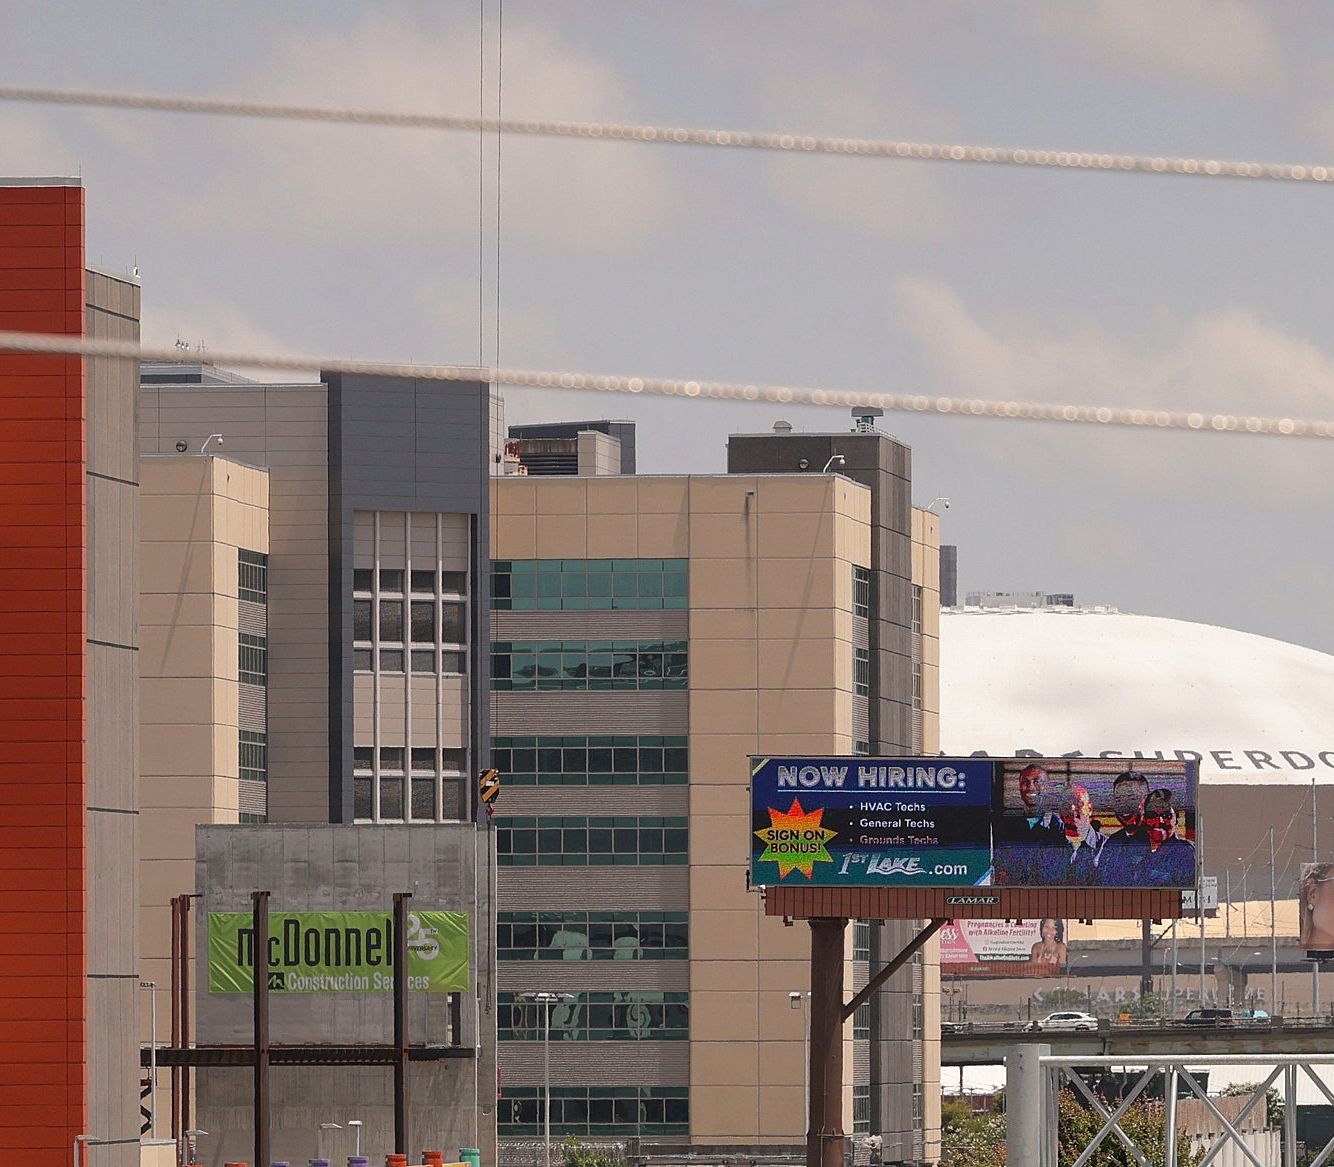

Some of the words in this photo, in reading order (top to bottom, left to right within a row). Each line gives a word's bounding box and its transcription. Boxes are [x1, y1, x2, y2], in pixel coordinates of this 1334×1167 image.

[777, 766, 849, 788] NOW
[857, 766, 967, 789] HIRING:
[860, 802, 892, 812] HVAC
[895, 802, 926, 812] Techs
[859, 818, 902, 828] General
[905, 818, 935, 828] Techs
[767, 829, 801, 841] SIGN
[803, 829, 825, 841] ON
[859, 835, 905, 845] Grounds
[908, 835, 939, 845] Techs
[770, 843, 821, 854] BONUS!
[237, 918, 395, 967] mcDonnel
[288, 972, 368, 991] Construction
[373, 972, 430, 990] Serces
